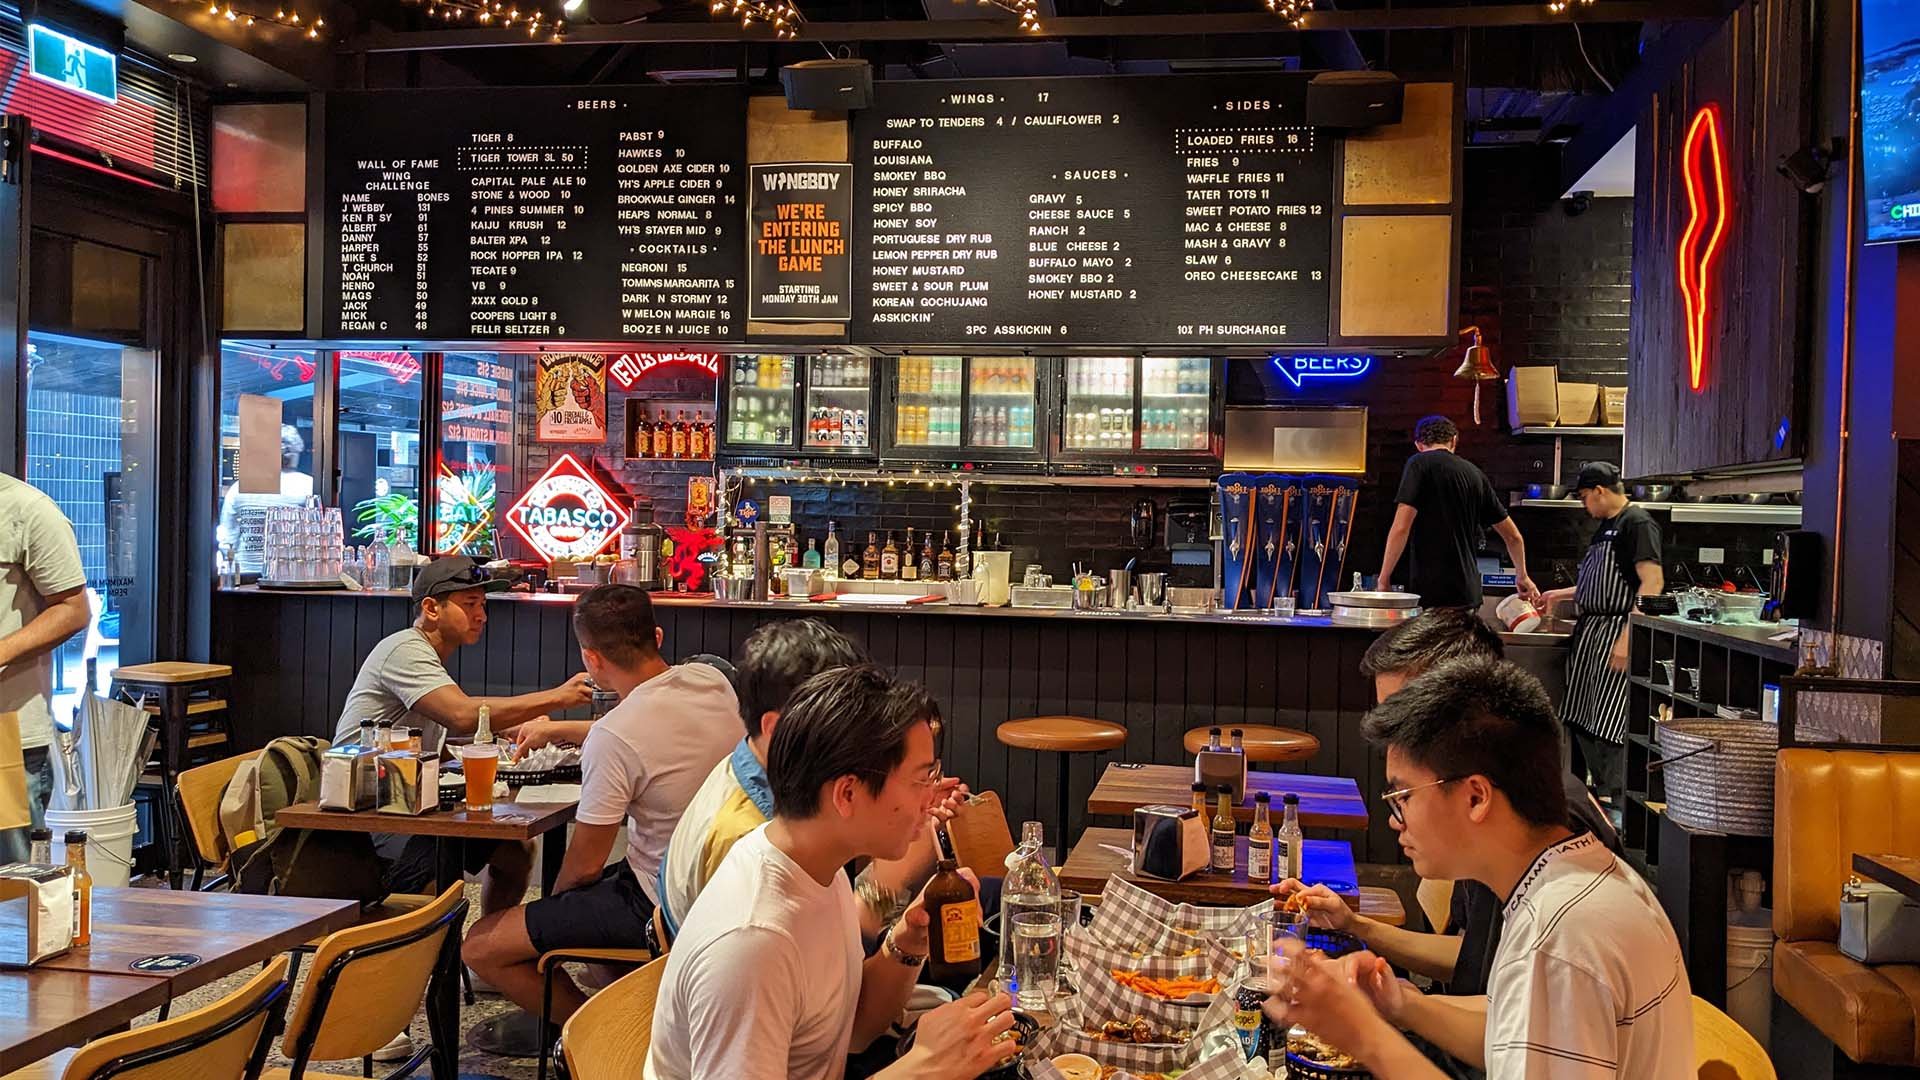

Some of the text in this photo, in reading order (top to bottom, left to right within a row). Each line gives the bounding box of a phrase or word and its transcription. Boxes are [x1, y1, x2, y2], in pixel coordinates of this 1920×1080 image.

[951, 92, 1049, 104] WINGS 17
[577, 100, 616, 110] BEERS
[1226, 100, 1271, 111] SIDES
[873, 139, 922, 150] BUFFALO
[1187, 134, 1298, 146] LOADED FRIES 16
[471, 153, 574, 163] TIGER TOWER 3L 50
[618, 148, 685, 158] HAWKES 10
[357, 159, 439, 169] WALL OF FAME
[874, 155, 933, 165] LOUISIANA
[1187, 157, 1239, 167] FRIES 9
[617, 164, 730, 173] GOLDEN AXE CIDER 10
[382, 171, 411, 181] WING
[873, 171, 947, 181] SMOKEY BBQ
[1064, 170, 1117, 180] SAUCES
[1186, 173, 1284, 184] WAFFLE FRIES 11
[365, 181, 430, 191] CHALLENGE
[471, 176, 587, 186] CAPITAL PALE ALE 10
[873, 186, 966, 197] HONEY SRIRACHA
[1186, 189, 1269, 200] TATER TOTS 11
[342, 192, 450, 203] NAME BONES
[617, 194, 735, 204] BROOKVALE GINGER 14
[342, 203, 431, 213] J WEBBY 131
[777, 204, 825, 219] WE'RE
[873, 202, 933, 213] SPICY BBQ
[1185, 205, 1322, 217] SWEET POTATO FRIES 12
[1028, 209, 1130, 220] CHEESE SAUCE 5
[341, 223, 428, 233] ALBERT 61
[471, 220, 567, 230] KAIJU KRUSH 12
[873, 218, 937, 228] HONEY SOY
[763, 221, 839, 237] ENTERING
[341, 233, 429, 243] DANNY 57
[470, 235, 551, 245] BALTER XPA 12
[873, 233, 992, 244] PORTUGUESE DRY RUB
[341, 243, 429, 253] HARPER 55
[638, 244, 707, 254] COCKTAILS
[758, 239, 844, 255] THE LUNCH
[470, 251, 583, 260] ROCK HOPPER IPA 12
[873, 249, 998, 260] LEMON PEPPER DRY RUB
[621, 263, 687, 273] NEGRONI 15
[779, 256, 822, 272] GAME
[873, 265, 965, 276] HONEY MUSTARD
[342, 271, 426, 281] NOAH 51
[1028, 273, 1114, 284] SMOKEY BBQ 2
[1184, 271, 1322, 281] OREO CHEESECAKE 13
[342, 281, 428, 291] HENRO 50
[779, 285, 820, 294] STARTING
[342, 291, 428, 300] MAGS 50
[762, 294, 838, 304] MONDAY 30TH JAN
[1028, 289, 1137, 299] HONEY MUSTARD 2
[342, 301, 427, 310] JACK 49
[872, 297, 988, 307] KOREAN GOCHUJANG
[341, 311, 427, 320] MICK 48
[1177, 325, 1286, 335] 10% PH SURCHARGE
[518, 506, 618, 529] TABASCO
[1555, 836, 1592, 855] ATH
